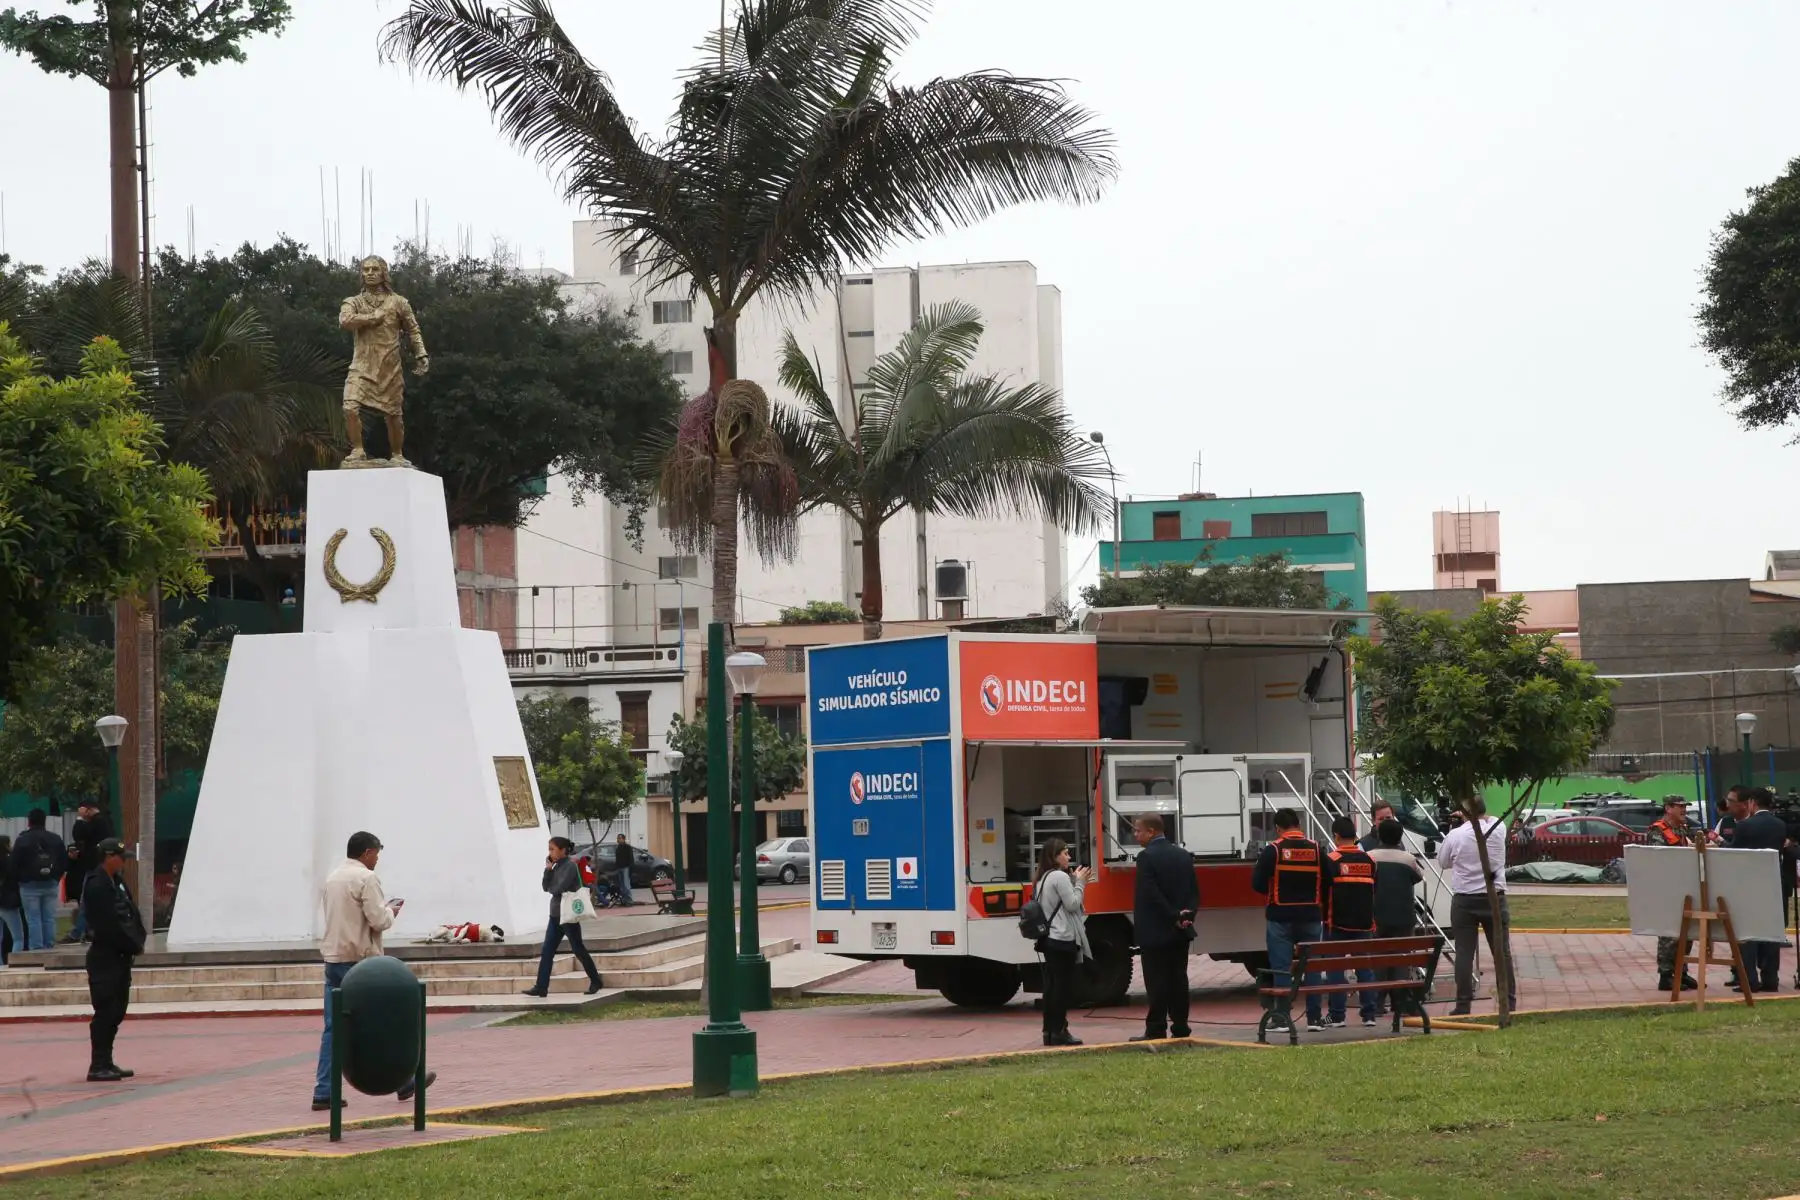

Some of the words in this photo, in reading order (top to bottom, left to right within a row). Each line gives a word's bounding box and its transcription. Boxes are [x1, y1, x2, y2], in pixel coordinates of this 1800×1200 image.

[848, 669, 907, 690] VEHÍCULO
[818, 692, 888, 712] SIMULADOR
[890, 686, 940, 706] SÍSMICO
[1006, 679, 1085, 703] INDECI
[866, 772, 918, 793] INDECI
